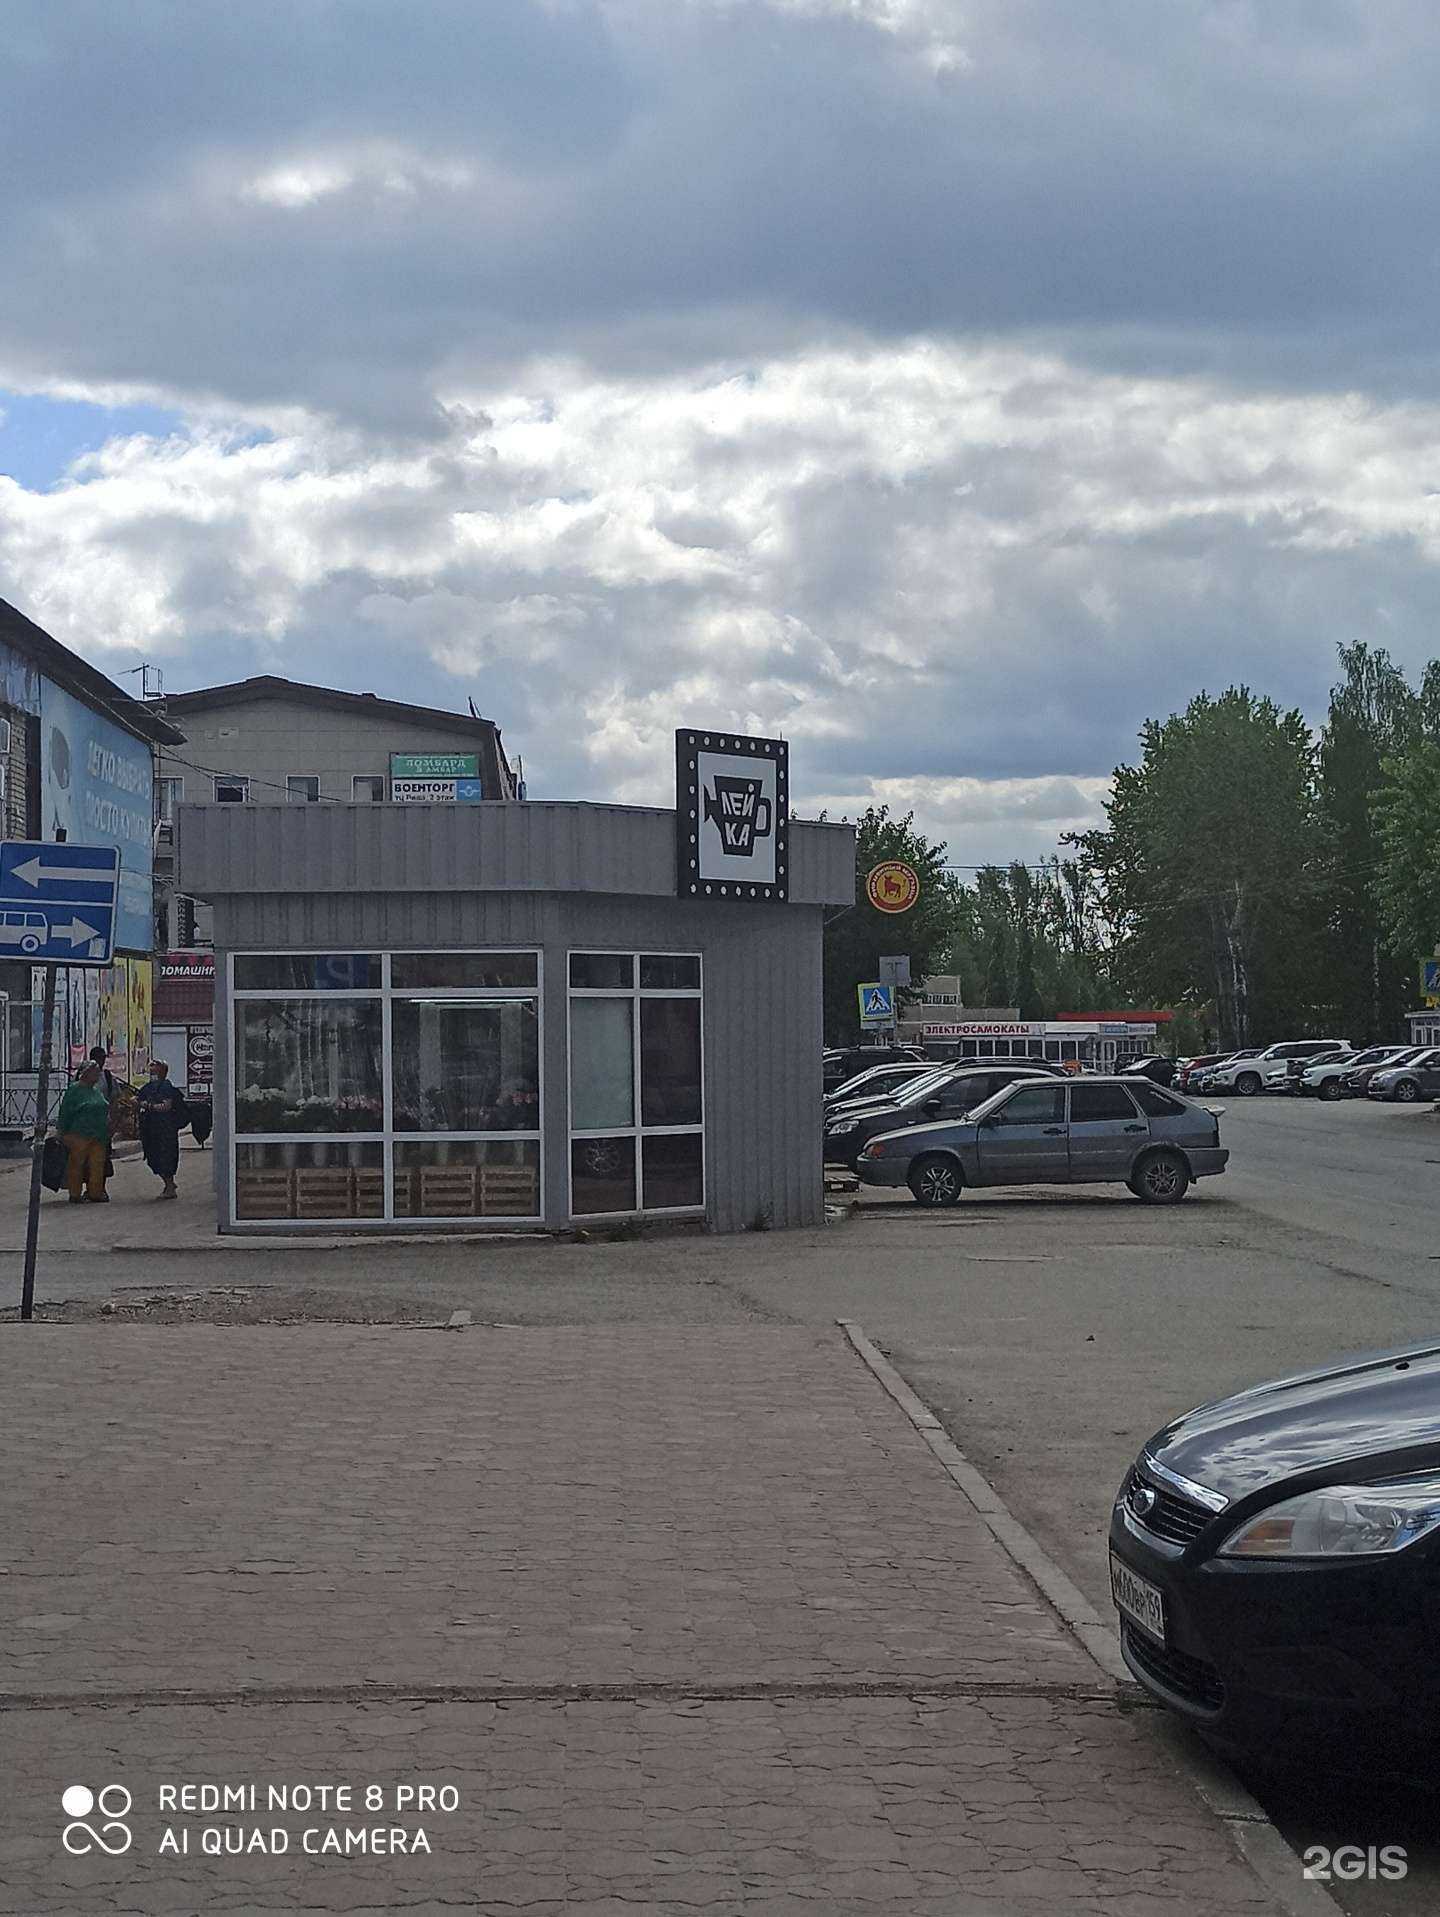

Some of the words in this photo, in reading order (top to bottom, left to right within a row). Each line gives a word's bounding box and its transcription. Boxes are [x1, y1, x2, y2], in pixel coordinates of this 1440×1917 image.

[394, 783, 455, 792] ВОЕНТОРГ
[721, 783, 755, 816] ЛЕЙ
[724, 822, 750, 846] КА
[925, 1025, 1029, 1034] ЭЛЕКТРОСАМОКАТЫ
